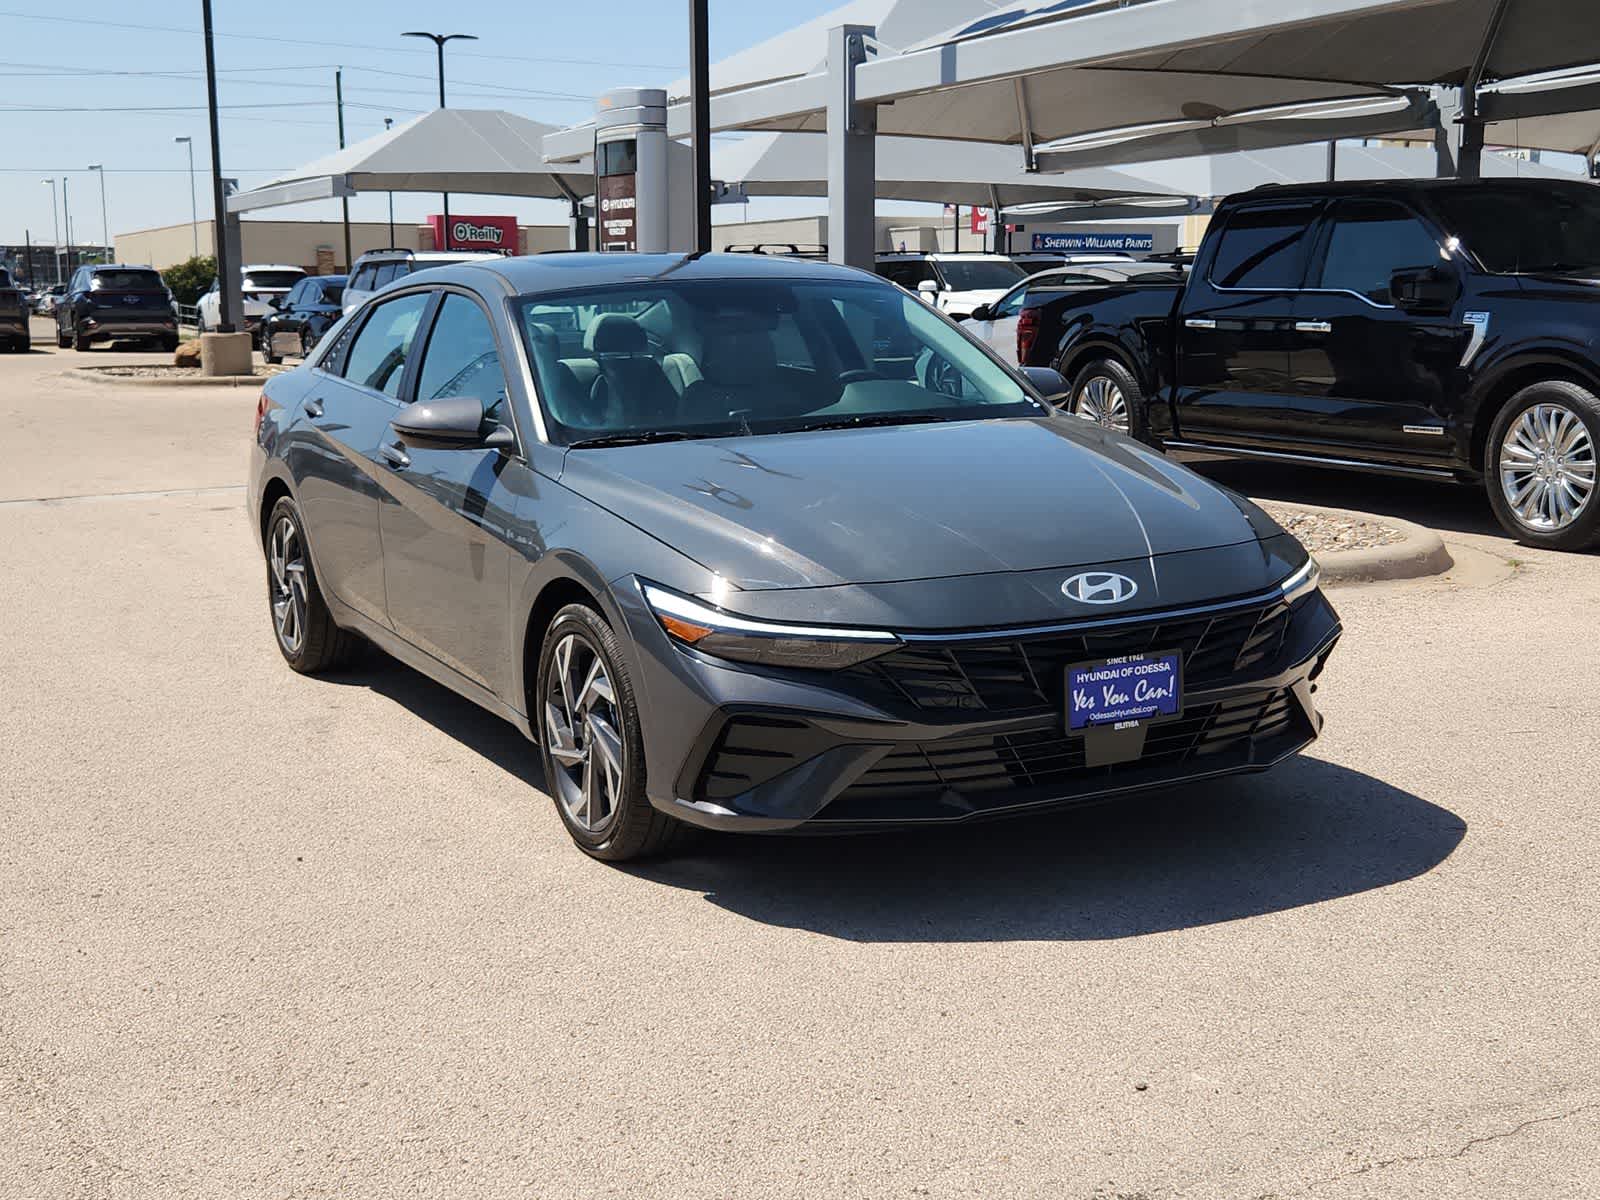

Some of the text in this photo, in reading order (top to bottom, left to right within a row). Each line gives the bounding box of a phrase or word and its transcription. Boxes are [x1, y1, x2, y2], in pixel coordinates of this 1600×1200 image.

[453, 223, 503, 244] O'Reilly
[1124, 238, 1152, 248] PAINTS
[1106, 655, 1127, 665] SINCE
[1076, 662, 1171, 683] HYUNDAI OF ODESSA
[1073, 674, 1175, 711] Yes You Can!
[1089, 705, 1158, 720] OdessaHyundai.com
